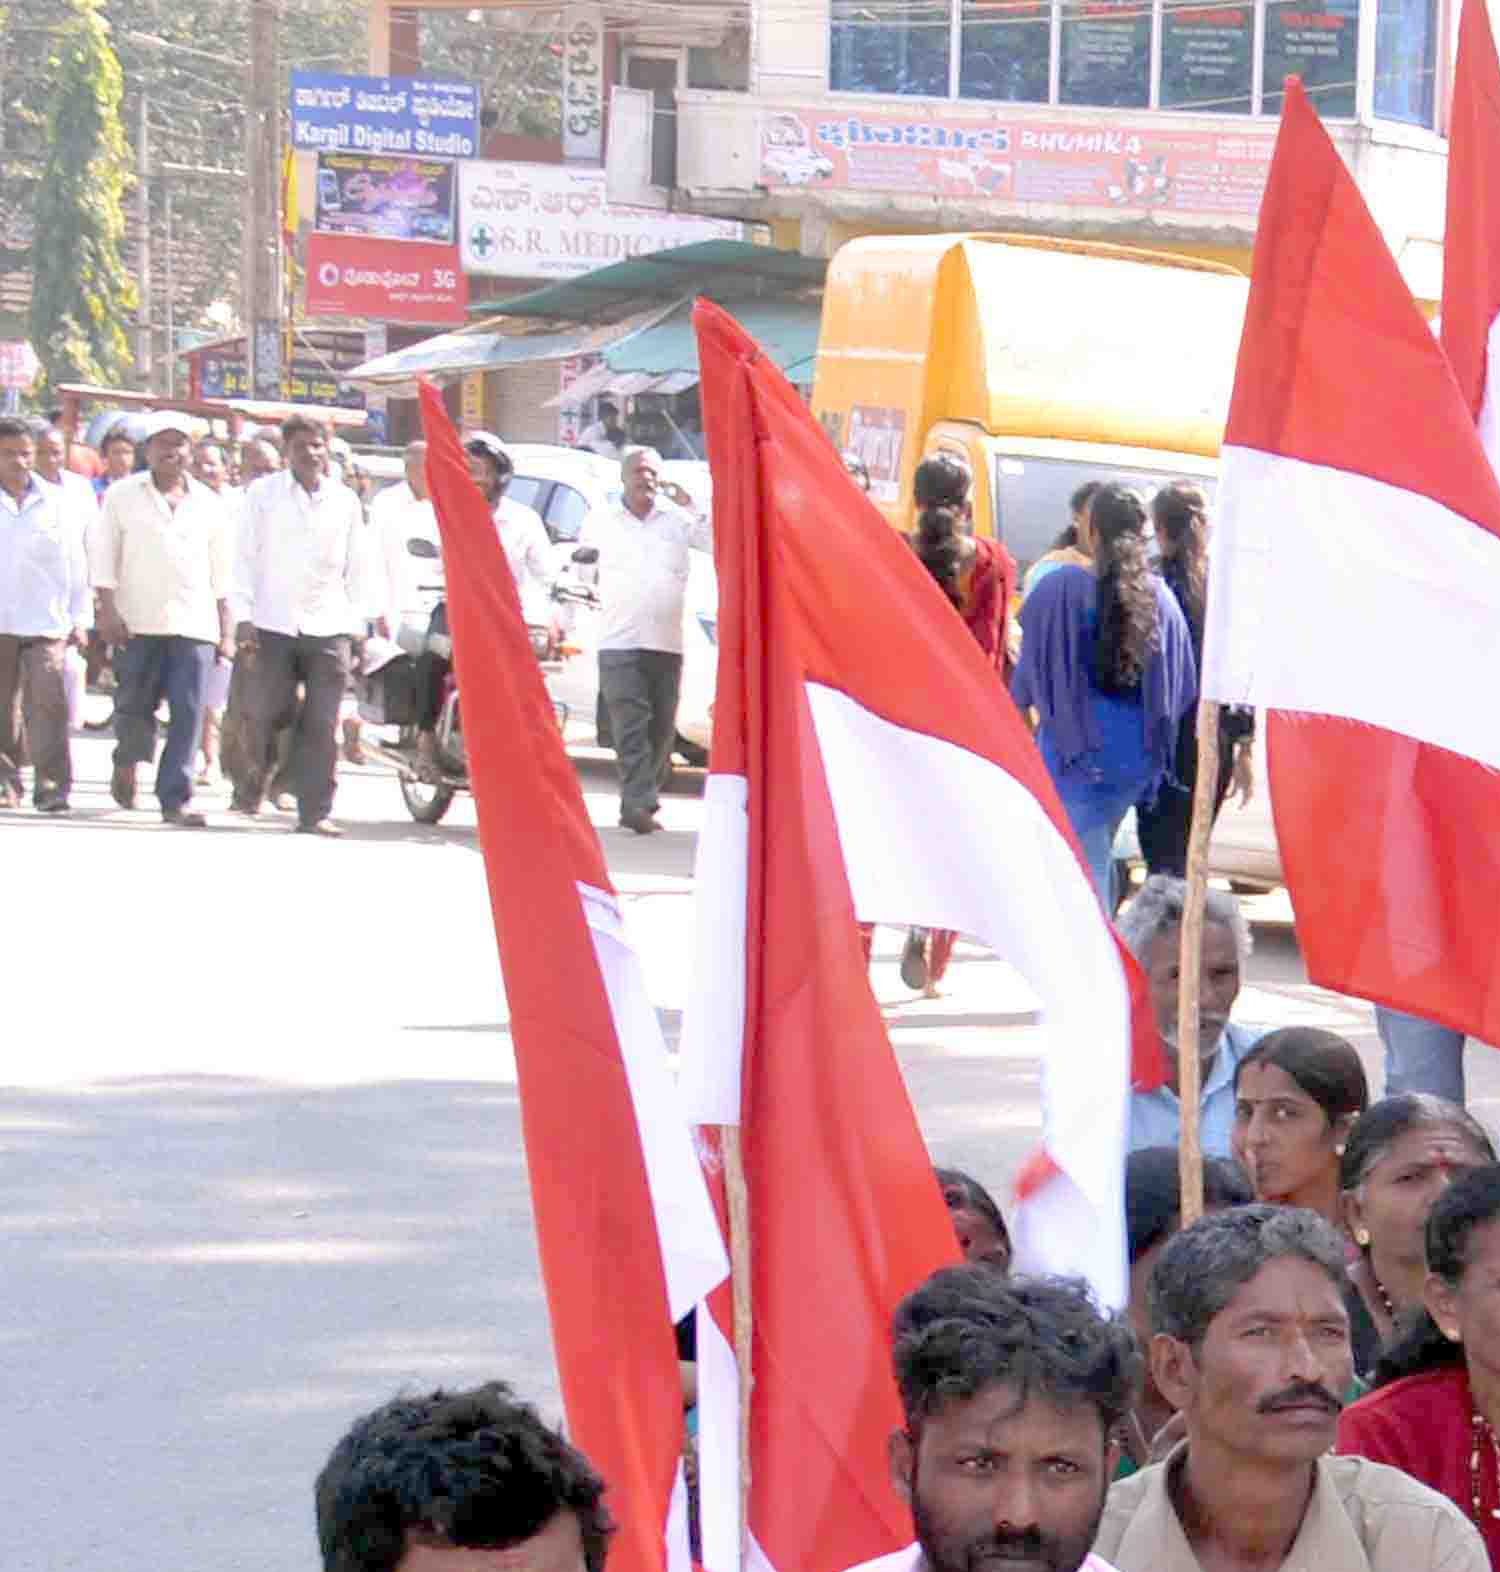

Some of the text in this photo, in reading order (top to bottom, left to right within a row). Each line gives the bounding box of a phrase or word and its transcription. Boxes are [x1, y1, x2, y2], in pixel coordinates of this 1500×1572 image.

[294, 120, 473, 156] Kargil Digital Studio
